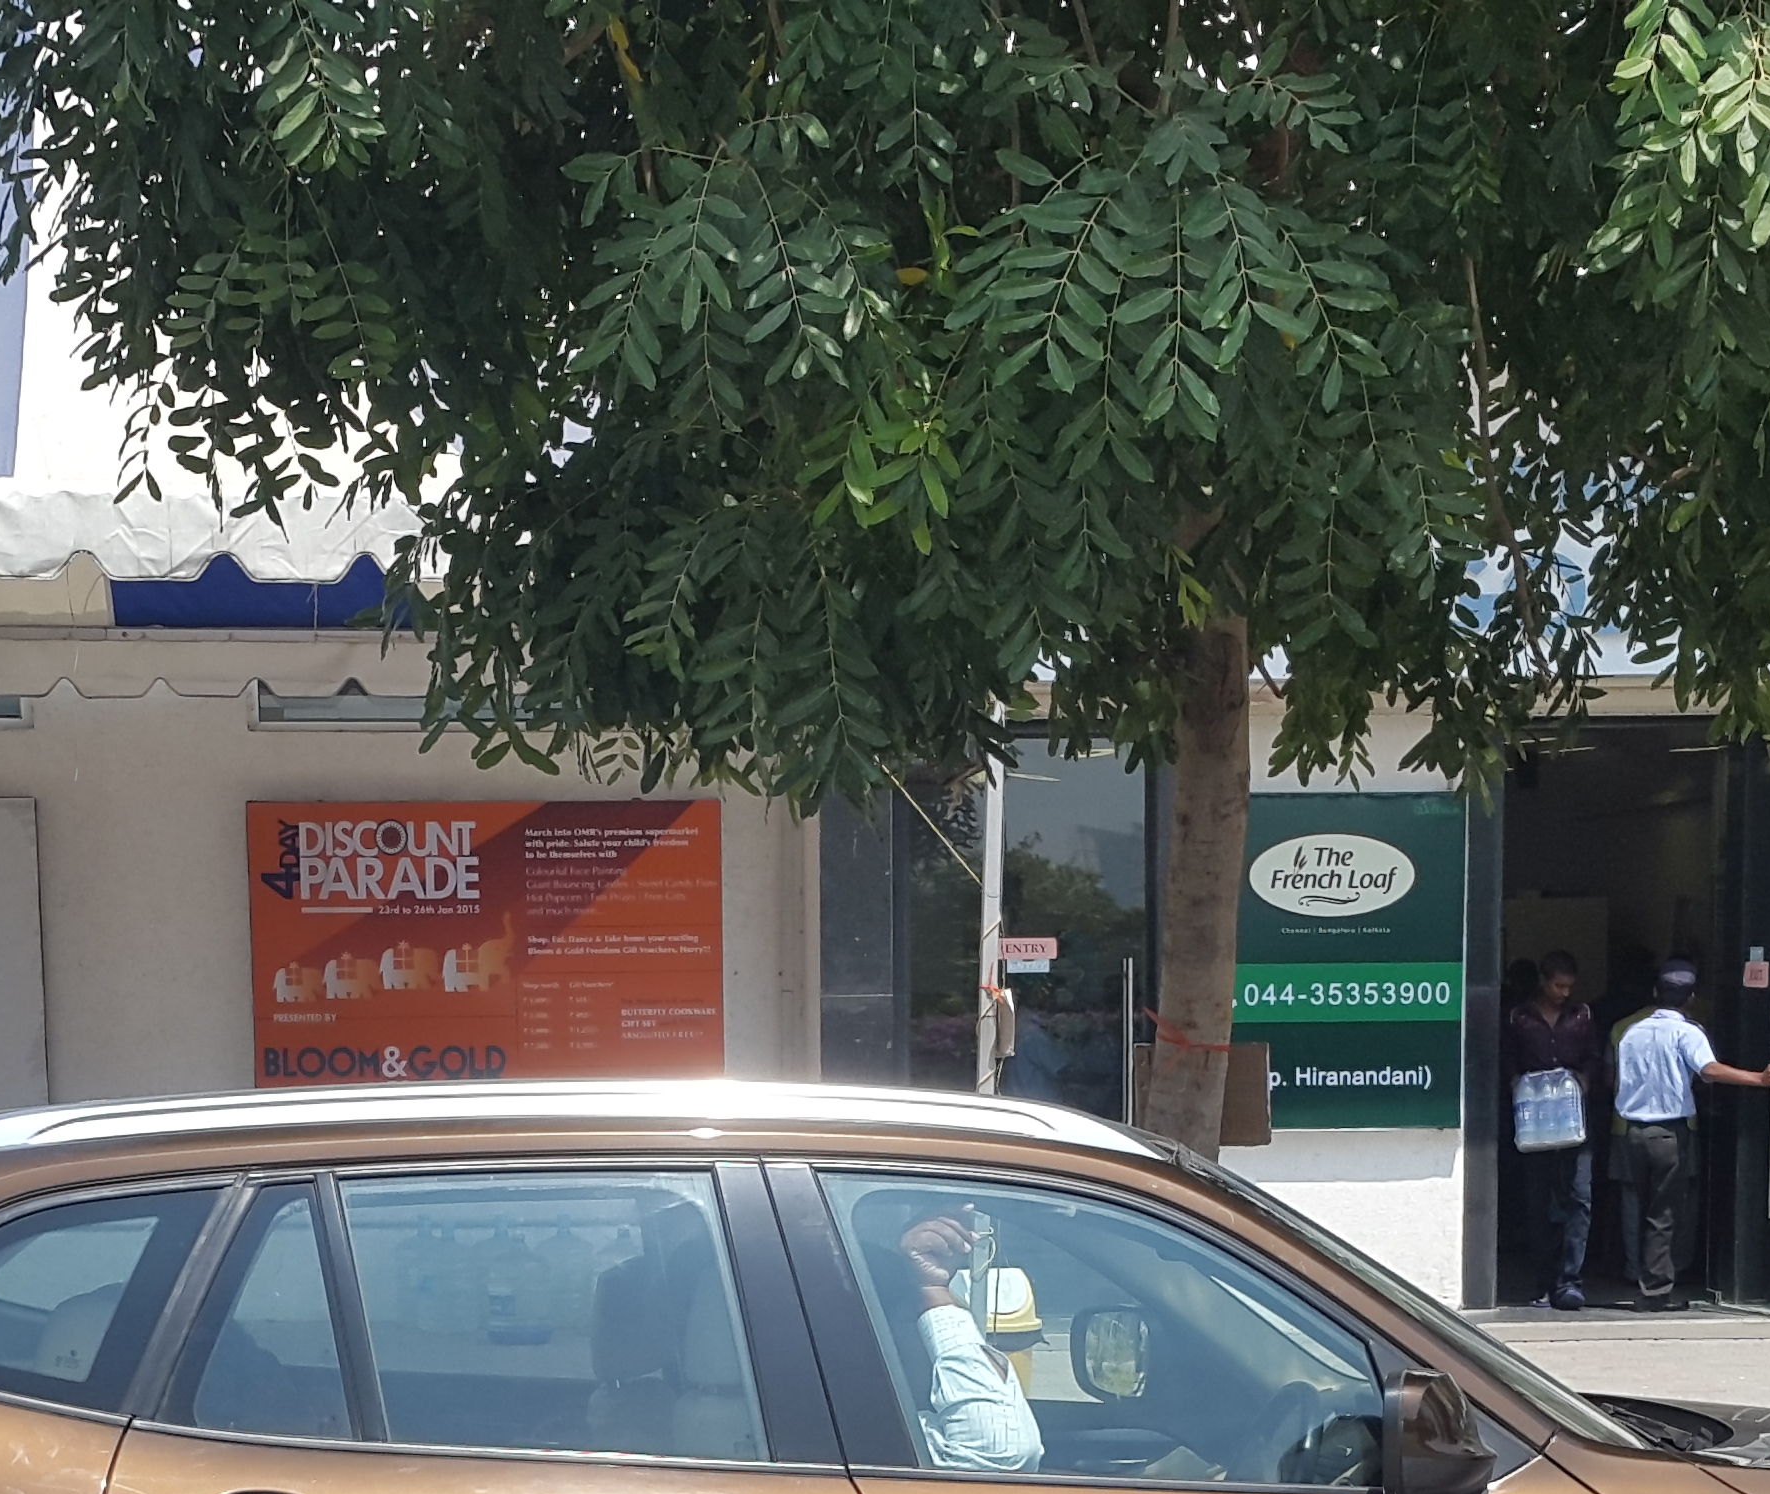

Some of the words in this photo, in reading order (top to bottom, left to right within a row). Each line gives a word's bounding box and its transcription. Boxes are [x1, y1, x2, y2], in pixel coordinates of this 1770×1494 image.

[298, 820, 476, 856] DISCOUNT
[525, 829, 552, 837] March
[554, 828, 571, 836] into
[574, 828, 601, 836] OMR's
[604, 828, 643, 838] premium
[645, 827, 698, 839] supermarket
[525, 840, 544, 848] with
[602, 840, 622, 848] your
[653, 839, 689, 847] freedom
[525, 851, 535, 859] to
[536, 851, 547, 859] be
[549, 851, 596, 859] themselves
[598, 850, 618, 858] with
[1314, 847, 1354, 866] The
[300, 857, 480, 899] PARADE
[1271, 869, 1342, 889] French
[1347, 866, 1398, 894] Loaf
[379, 905, 399, 914] 23rd
[403, 905, 412, 914] to
[414, 905, 434, 914] 26th
[437, 905, 453, 914] Jan
[456, 905, 480, 914] 2015
[1005, 943, 1046, 954] ENTRY
[1244, 981, 1451, 1006] 044-35353900
[274, 1013, 322, 1022] PRESENTED
[325, 1013, 337, 1022] BY
[1295, 1066, 1432, 1089] Hiranandani)
